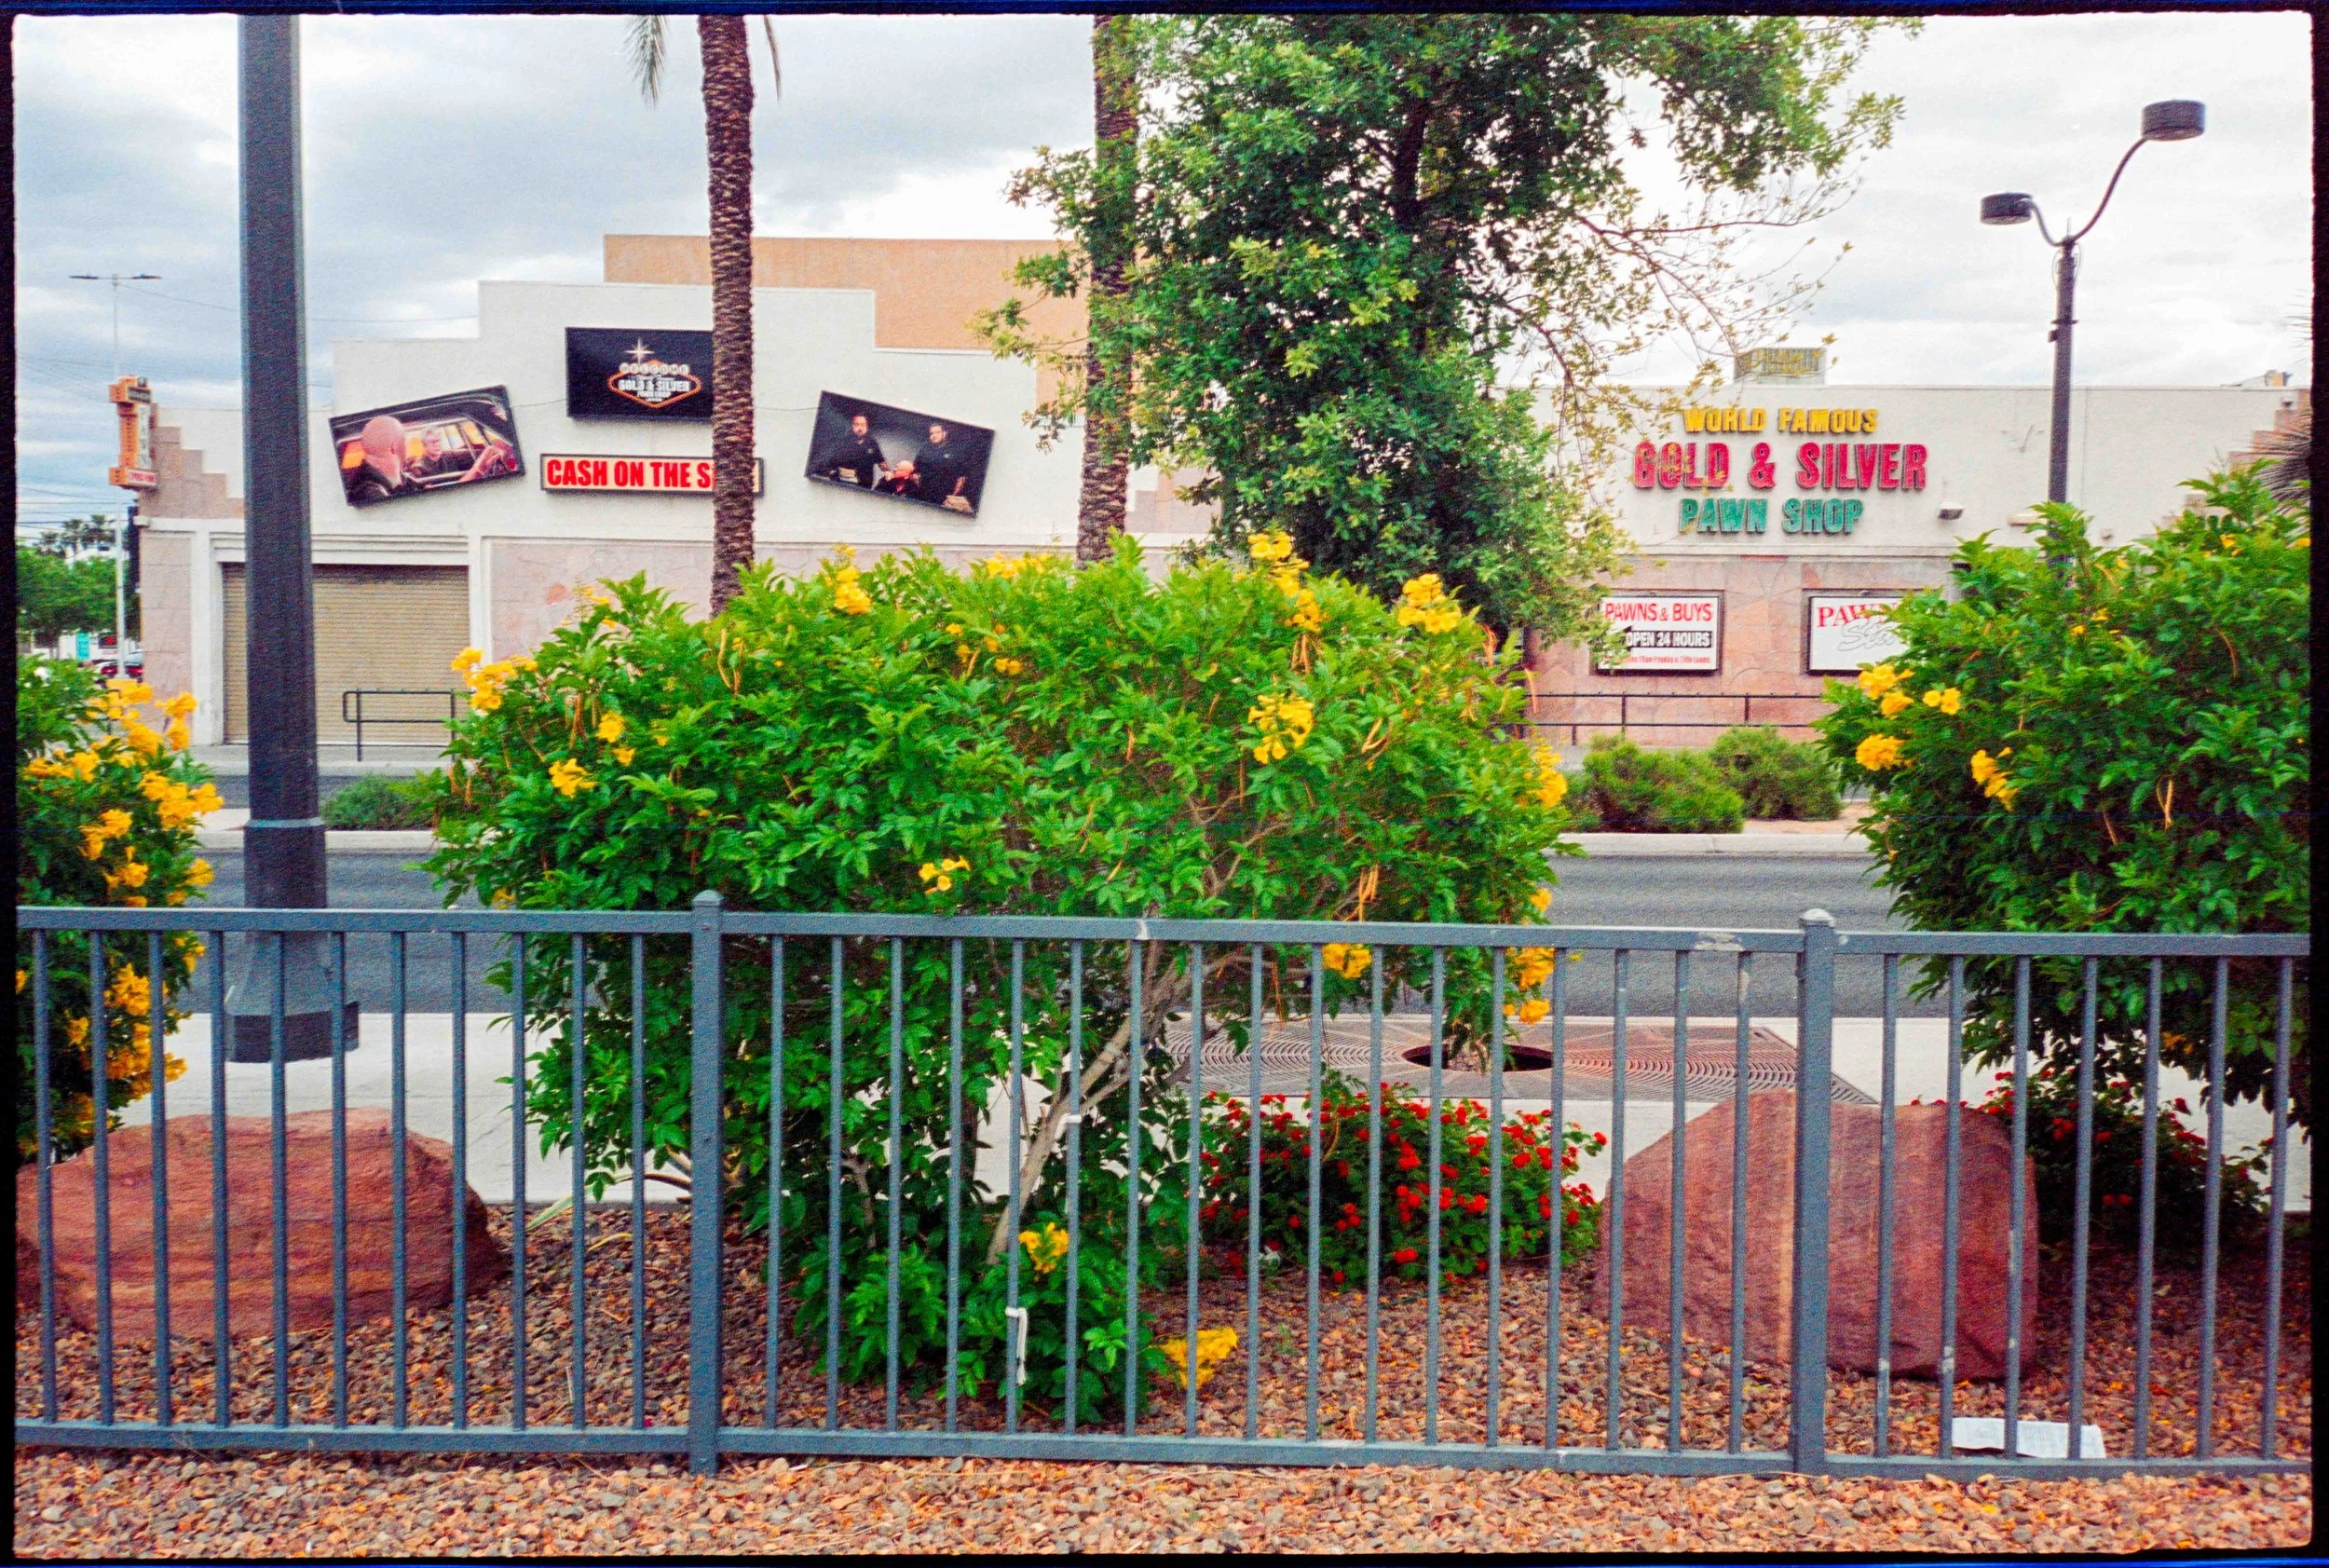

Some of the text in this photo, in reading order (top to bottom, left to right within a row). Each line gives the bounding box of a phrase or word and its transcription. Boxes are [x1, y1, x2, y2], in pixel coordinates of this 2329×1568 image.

[1683, 408, 1878, 433] WORLD FAMOUS
[547, 459, 608, 486] CASH
[614, 461, 645, 487] ON
[650, 462, 691, 487] THE
[1634, 442, 1928, 490] GOLD & SILVER
[1679, 498, 1863, 534] PAWN SHOP
[1604, 603, 1712, 621] PAWNS & BUYS
[1627, 632, 1710, 648] OPEN 24 HOURS
